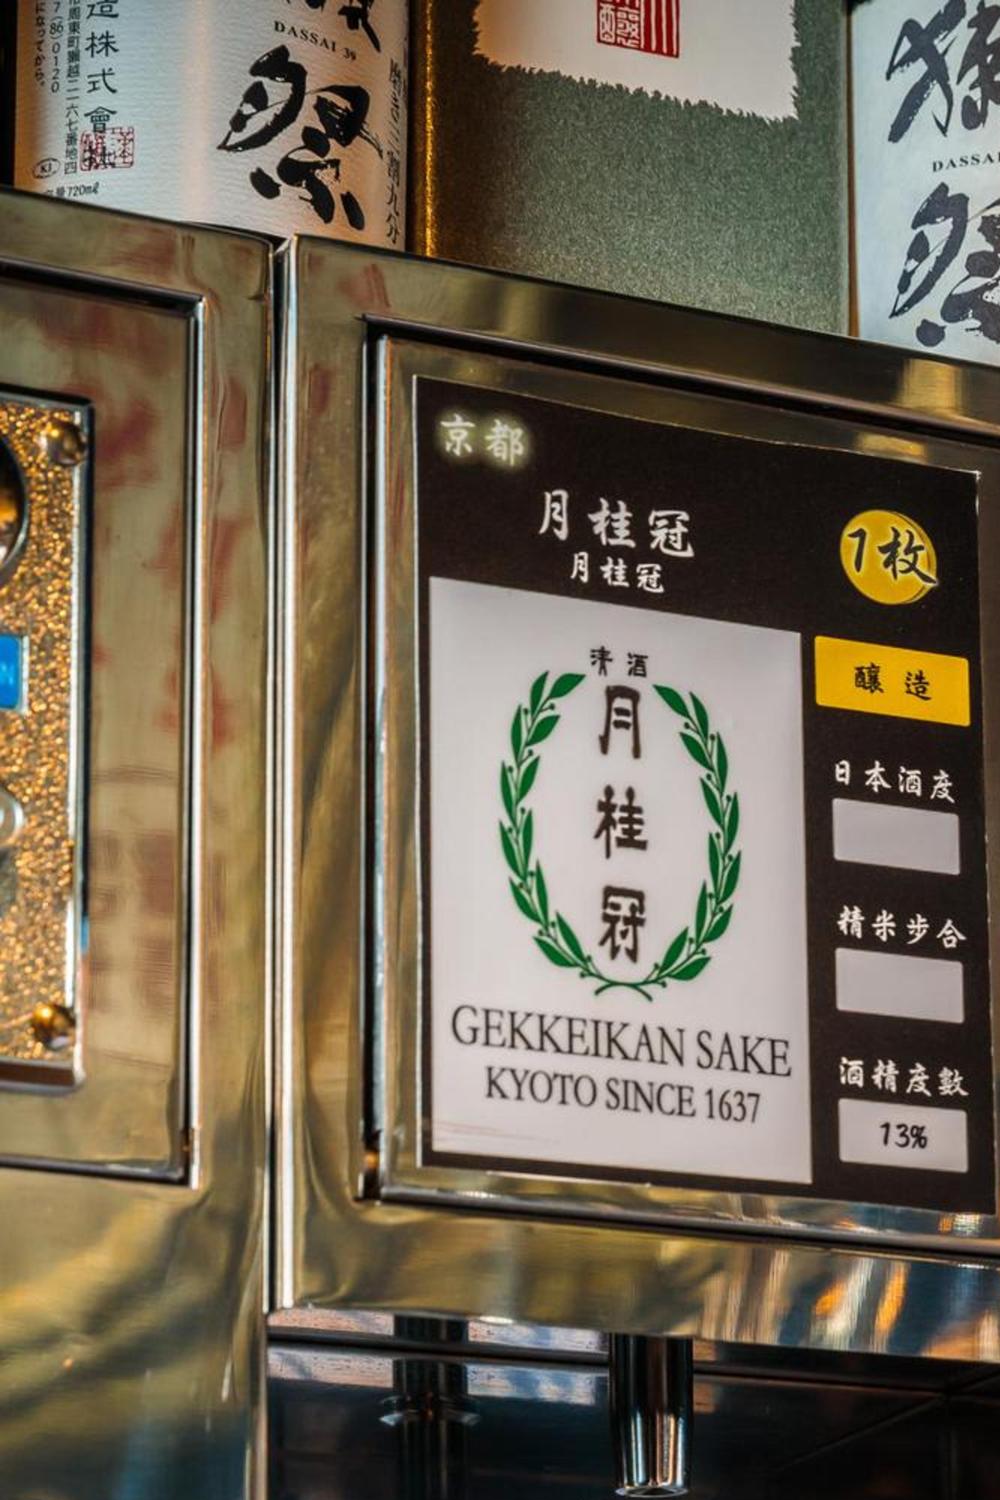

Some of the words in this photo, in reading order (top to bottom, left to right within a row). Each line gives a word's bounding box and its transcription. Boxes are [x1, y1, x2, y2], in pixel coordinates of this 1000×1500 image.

[274, 20, 336, 53] DASSAI
[439, 413, 527, 467] 京都
[537, 489, 696, 558] 月桂冠
[570, 551, 665, 594] 月桂冠
[846, 525, 938, 585] 1枚
[590, 645, 649, 678] 清酒
[834, 759, 956, 804] 日本酒度
[594, 685, 649, 964] 月桂冠
[450, 1004, 686, 1068] GEKKEIKAN
[696, 1029, 792, 1078] SAKE
[485, 1065, 597, 1109] KYOTO
[605, 1078, 697, 1119] SINCE
[705, 1088, 761, 1124] 1637
[839, 1056, 970, 1098] 酒精度數
[879, 1121, 929, 1149] 13%
